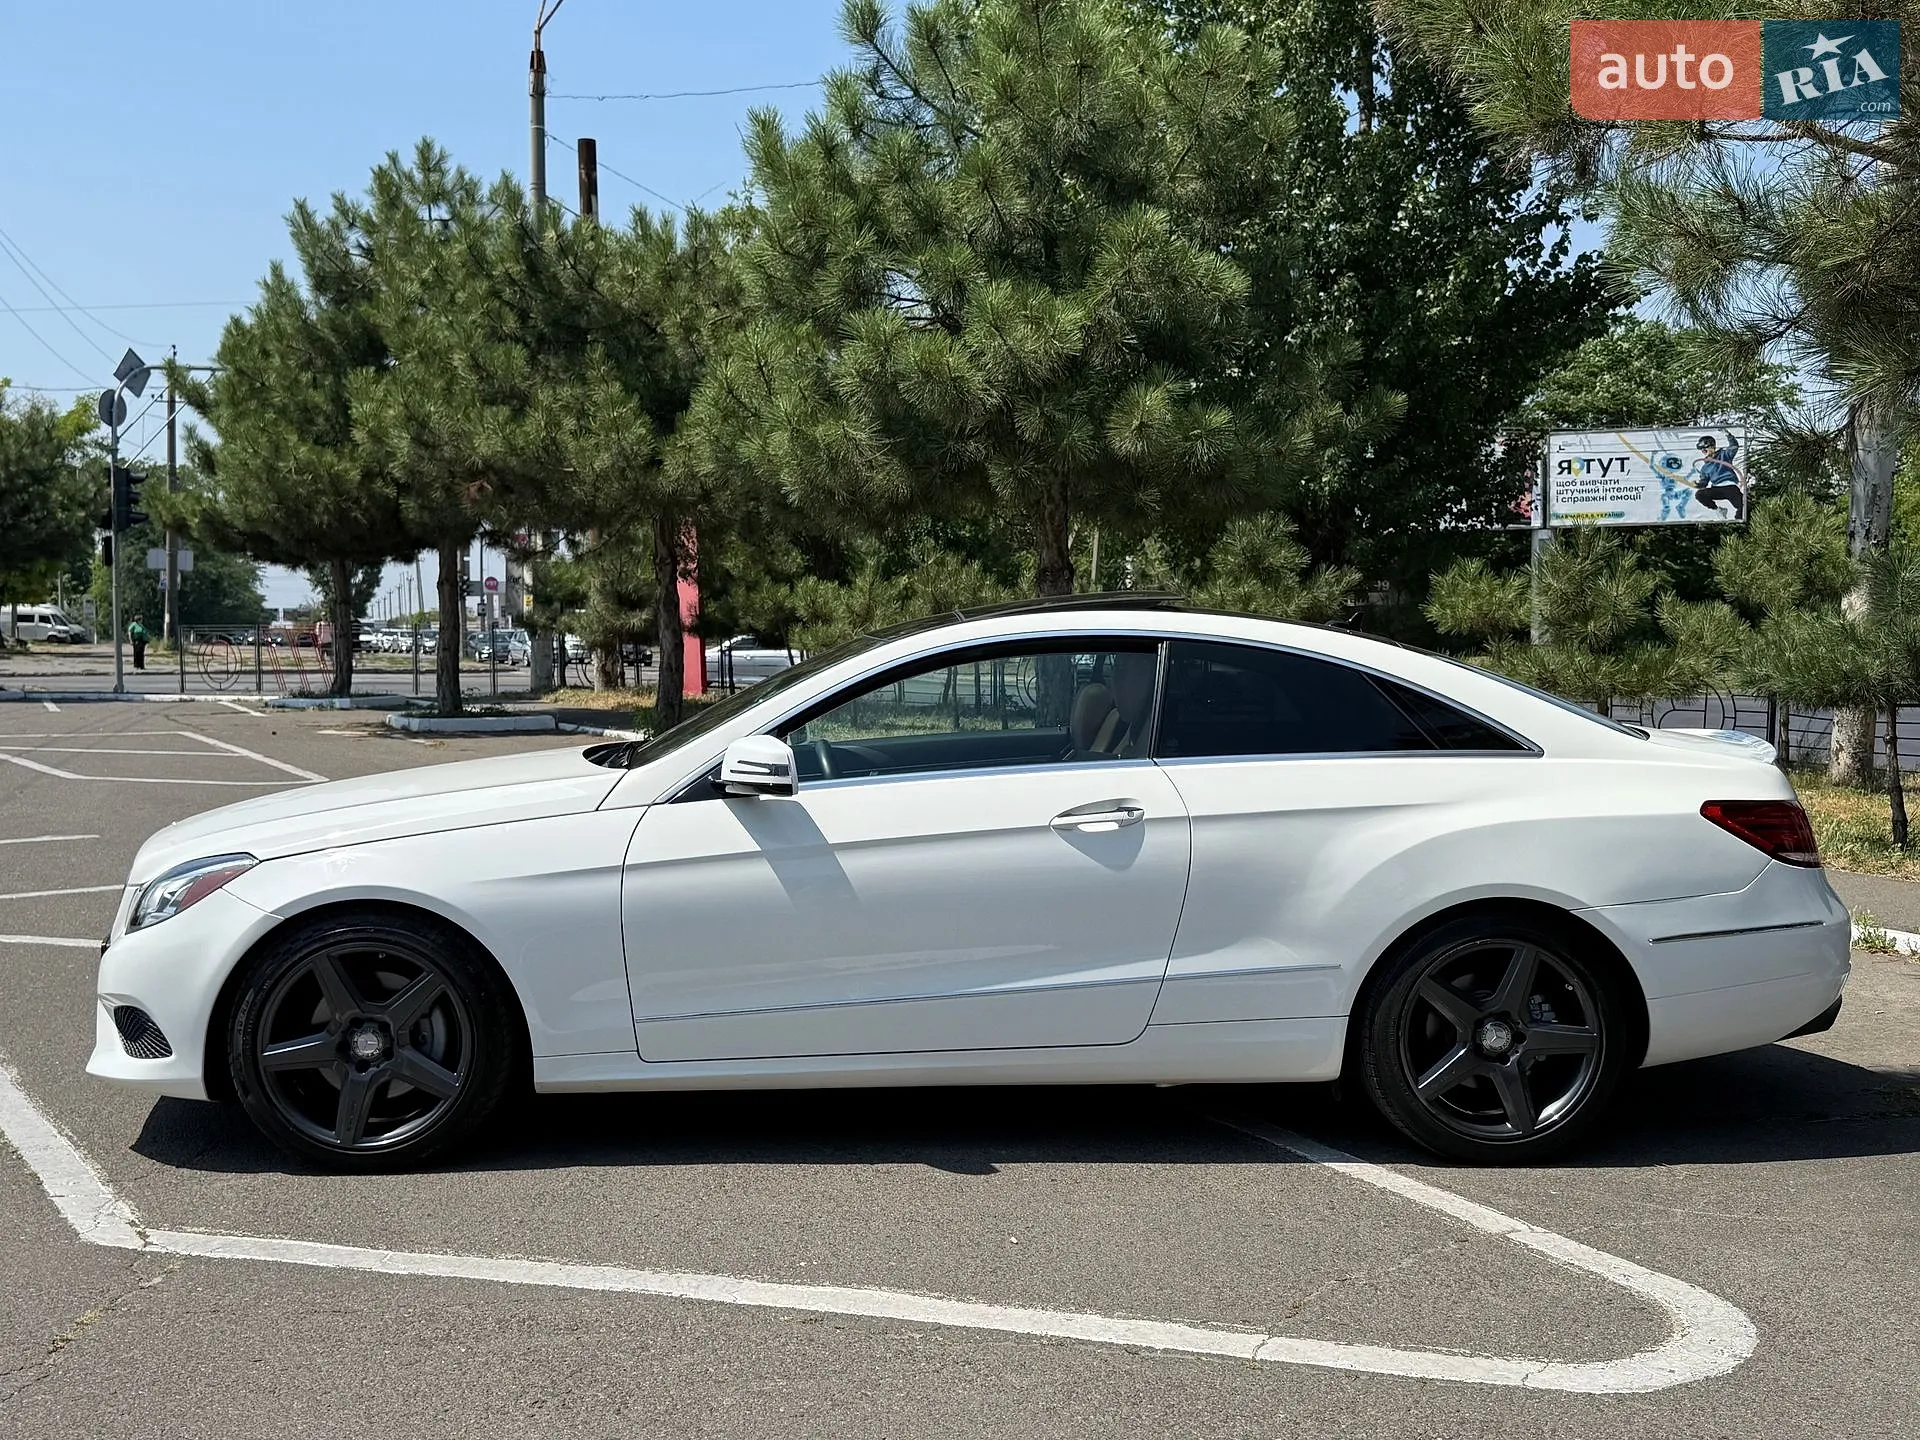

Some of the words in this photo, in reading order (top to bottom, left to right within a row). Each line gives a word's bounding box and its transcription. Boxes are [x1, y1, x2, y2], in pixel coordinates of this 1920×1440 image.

[1556, 479, 1577, 488] щоб
[1556, 486, 1600, 496] штучний
[1602, 485, 1645, 494] інтелект
[1561, 493, 1607, 504] справжні
[1609, 492, 1642, 502] емоції
